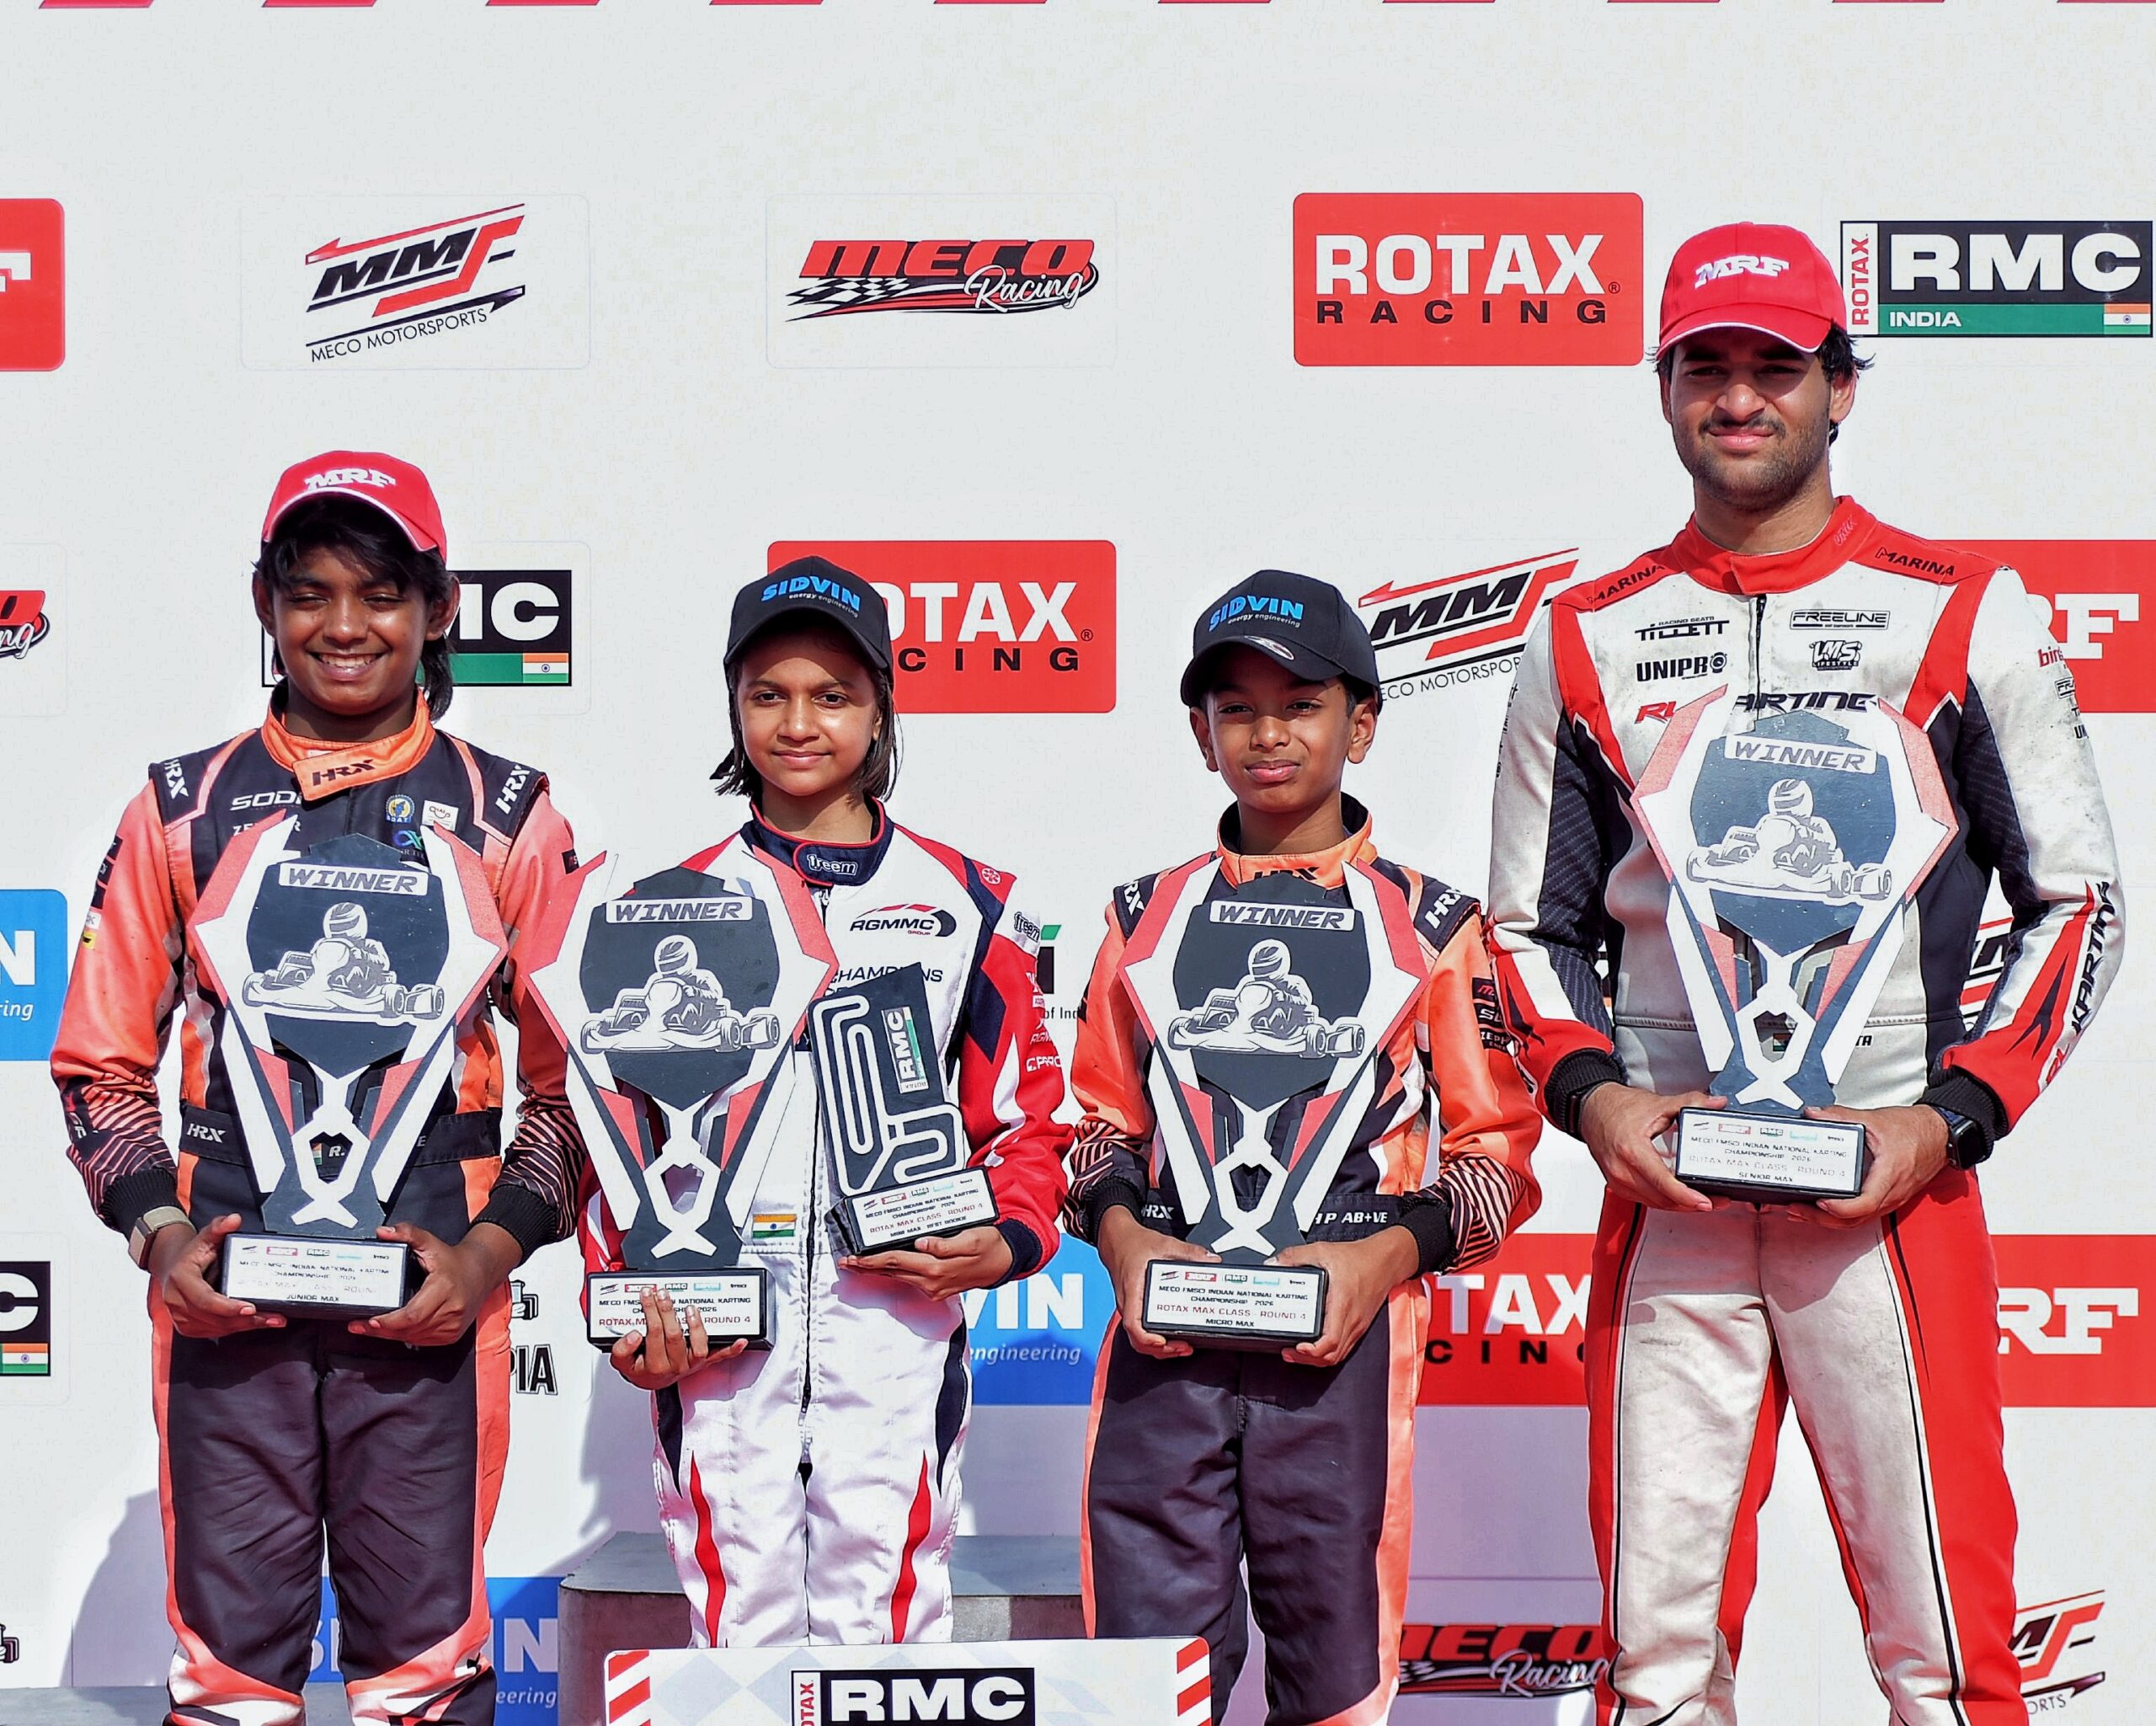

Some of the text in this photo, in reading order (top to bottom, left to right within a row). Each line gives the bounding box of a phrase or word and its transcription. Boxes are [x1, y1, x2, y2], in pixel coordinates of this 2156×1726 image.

[798, 239, 1095, 277] MECO
[1315, 234, 1606, 295] ROTAX
[1694, 254, 1790, 289] MRF
[1890, 232, 2142, 292] RMC
[963, 265, 1085, 313] Racing
[1851, 235, 1870, 326] ROTAX
[1316, 300, 1606, 324] RACING
[1889, 311, 1962, 328] INDIA
[311, 307, 488, 363] MECO MOTORSPORTS
[304, 468, 397, 492] MRF
[1875, 547, 1956, 577] MARINA
[760, 575, 862, 613] SIDVIN
[1587, 562, 1665, 606] MARINA
[788, 592, 859, 619] energy engineering
[867, 581, 1079, 642] OTAX
[1209, 594, 1305, 632] SIDVIN
[1792, 612, 1888, 623] FREELINE
[1228, 612, 1301, 630] energy engineering
[898, 648, 1079, 672] CING
[1380, 656, 1521, 702] ECO MOTORSPOR
[1735, 691, 1878, 713] ARTING
[1734, 740, 1866, 772] WINNER
[164, 759, 189, 800] HRX
[312, 759, 376, 787] HRX
[495, 765, 531, 815] HRX
[807, 853, 858, 876] freem
[288, 867, 418, 894] WINNER
[615, 900, 743, 922] WINNER
[1218, 905, 1345, 930] WINNER
[1014, 911, 1041, 943] freem
[887, 1012, 916, 1079] RMC
[187, 1122, 226, 1144] HRX
[1738, 1172, 1771, 1180] SENIOR
[869, 1223, 894, 1234] ROTAX
[897, 1218, 914, 1227] MAX
[916, 1212, 942, 1223] CLASS
[947, 1205, 975, 1216] ROUND
[1156, 1304, 1188, 1312] ROTAX
[1193, 1306, 1215, 1314] MAX
[1219, 1308, 1251, 1317] CLASS
[1260, 1311, 1296, 1319] ROUND
[1191, 1296, 1248, 1304] CHAMPIONSHIP
[1437, 1274, 1593, 1335] TAX
[599, 1318, 632, 1327] ROTAX
[1997, 1287, 2139, 1355] RF
[1425, 1339, 1584, 1364] CIN
[830, 1675, 1026, 1722] RMC
